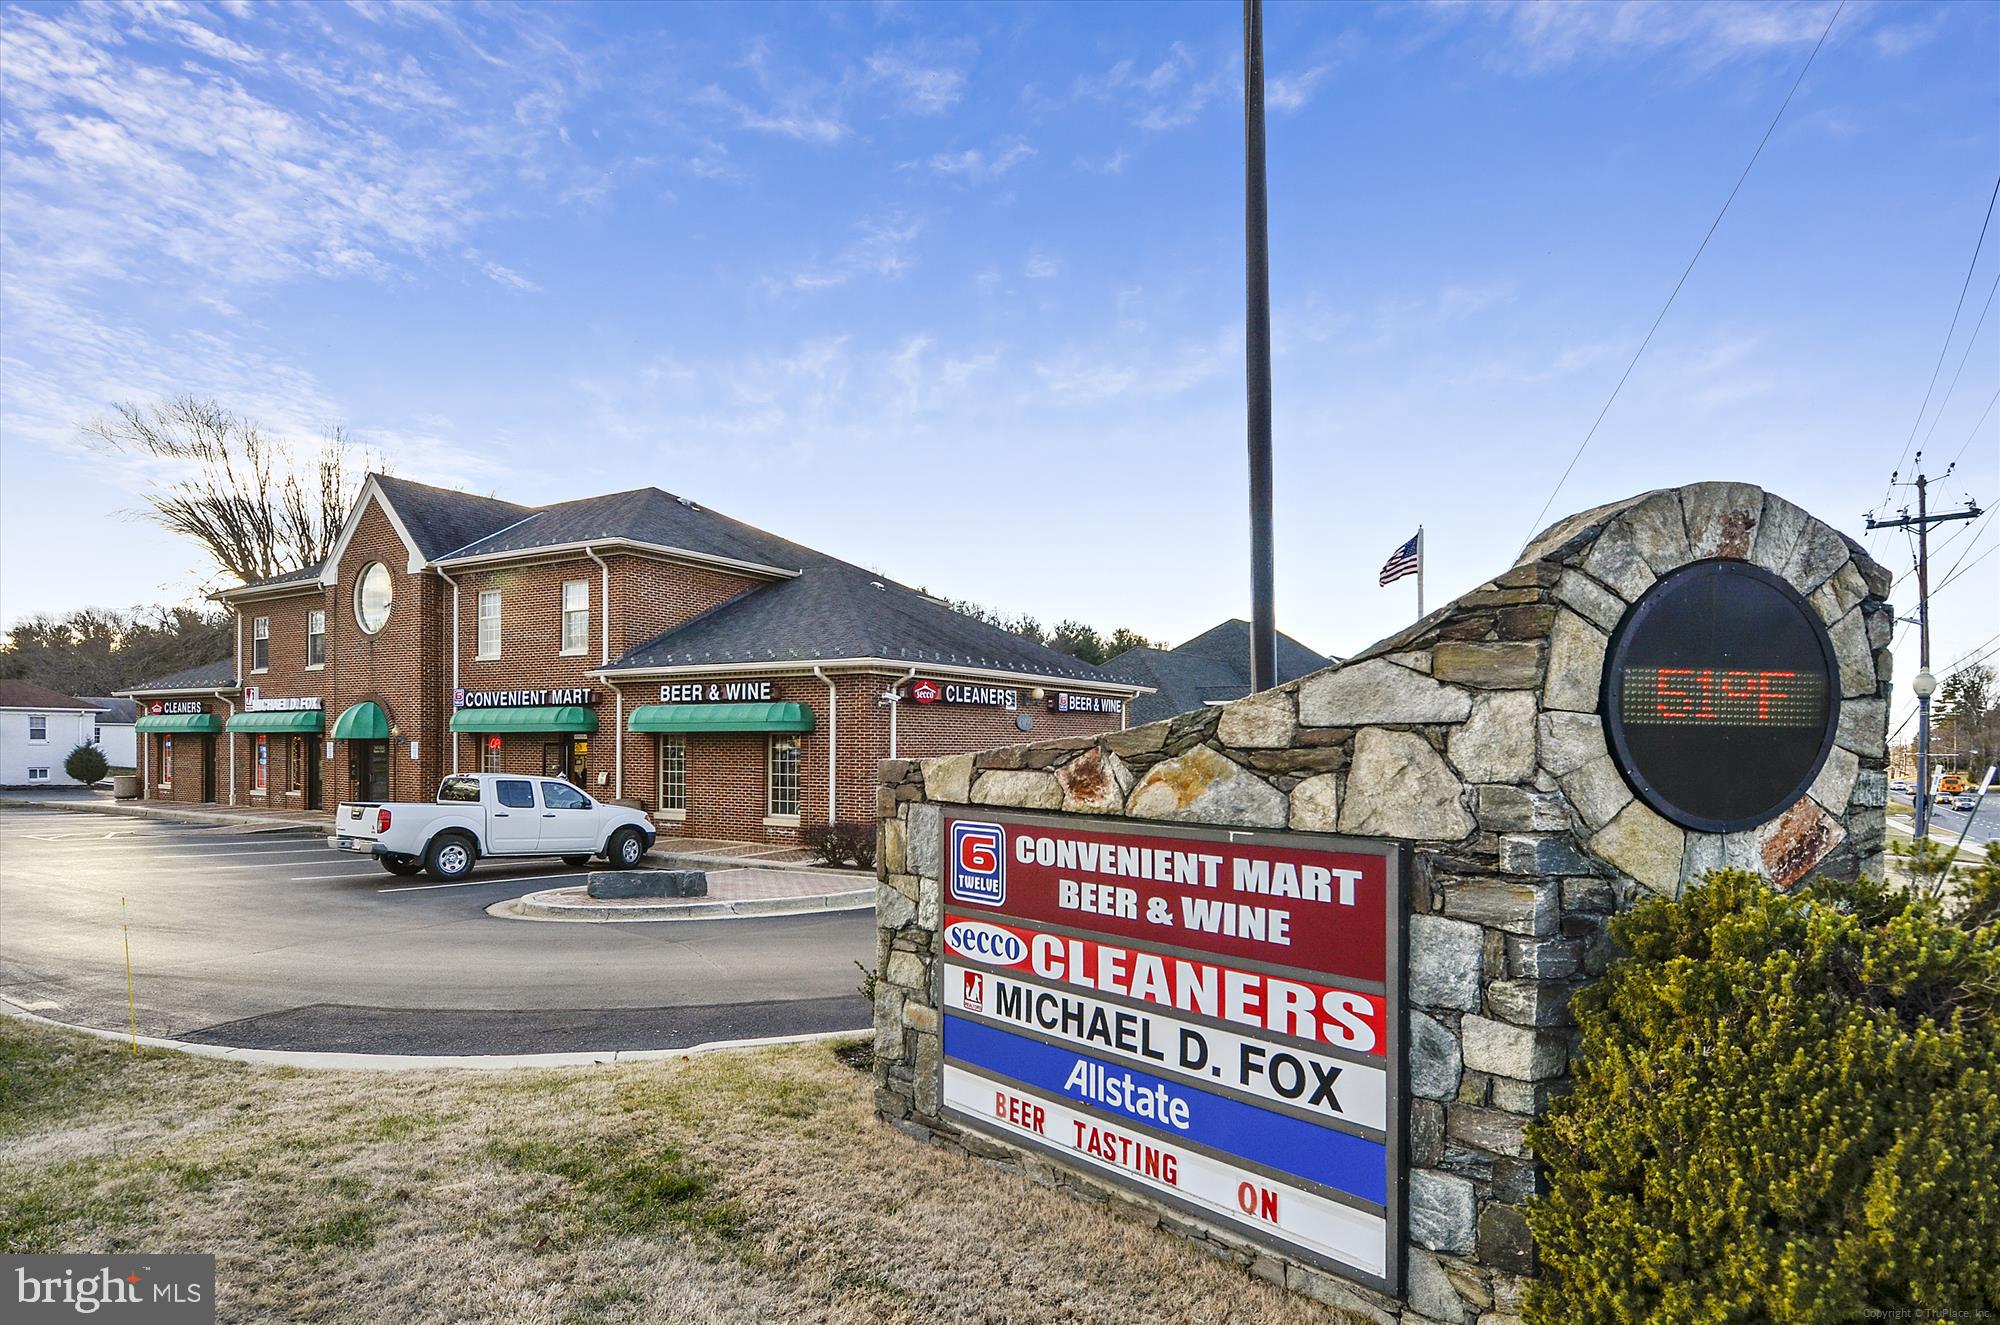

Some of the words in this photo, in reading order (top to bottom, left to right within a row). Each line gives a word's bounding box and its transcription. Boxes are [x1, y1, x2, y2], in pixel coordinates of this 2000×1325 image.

[164, 701, 202, 714] CLEANERS
[465, 691, 548, 707] CONVENIENT
[551, 688, 591, 704] MART
[660, 684, 703, 702] BEER
[709, 683, 720, 701] &
[726, 682, 771, 700] WINE
[945, 685, 1013, 706] CLEANERS
[1069, 696, 1092, 711] BEER
[1093, 699, 1100, 712] &
[1101, 698, 1122, 713] WINE
[960, 834, 997, 874] 6
[1015, 835, 1223, 888] CONVENIENT
[1232, 858, 1363, 906] MART
[958, 874, 999, 894] TWELVE
[1059, 879, 1138, 920] BEER
[1146, 896, 1174, 925] &
[1180, 896, 1291, 946] WINE
[950, 925, 1020, 964] secco
[1031, 933, 1377, 1053] CLEANERS
[996, 981, 1165, 1062] MICHAEL
[1179, 1027, 1222, 1078] D.
[1239, 1042, 1344, 1114] FOX
[1063, 1059, 1190, 1130] Allstate
[995, 1092, 1045, 1135] BEER
[1073, 1120, 1178, 1187] TASTING
[1237, 1181, 1279, 1225] ON
